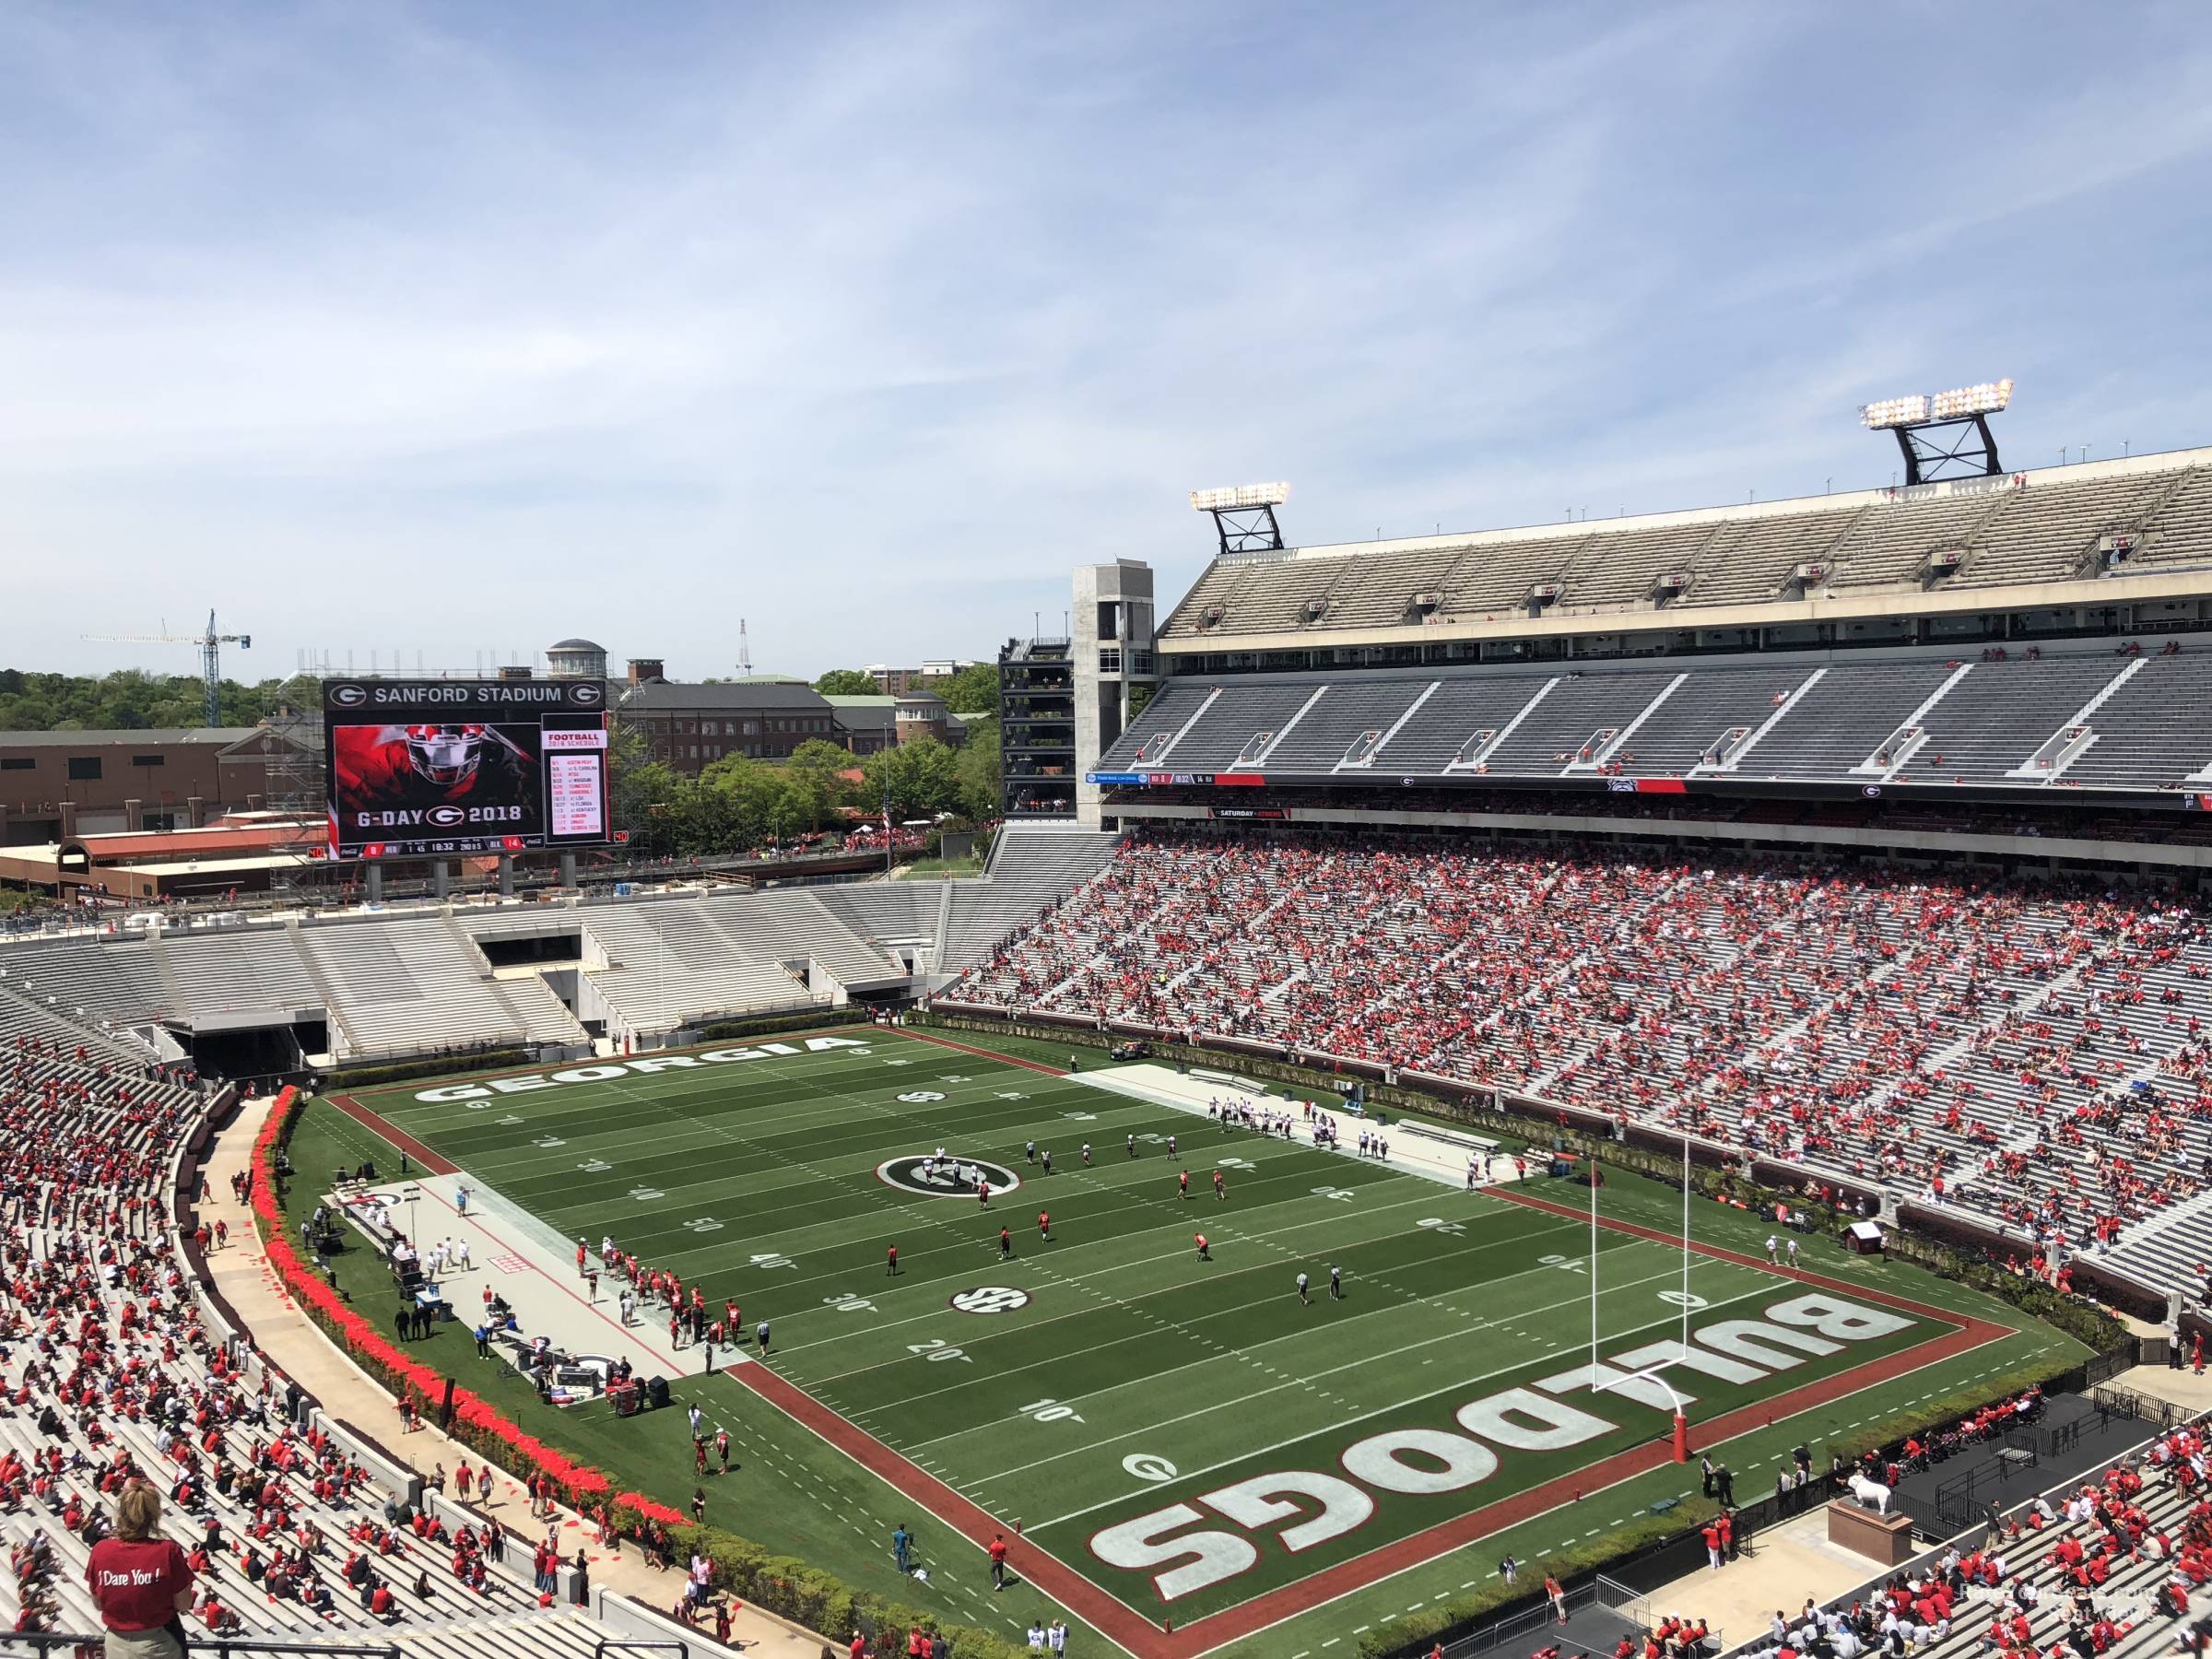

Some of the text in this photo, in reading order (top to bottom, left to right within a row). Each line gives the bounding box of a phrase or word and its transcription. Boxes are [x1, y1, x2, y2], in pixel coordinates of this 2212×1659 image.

[374, 687, 561, 702] SANFORD STADIUM
[358, 810, 422, 827] G-DAY
[469, 806, 521, 821] 2018
[508, 839, 516, 847] 14
[616, 831, 627, 841] 40
[310, 848, 323, 857] 40
[371, 846, 377, 855] 8
[431, 842, 454, 852] 18:32
[414, 1037, 872, 1102] GEORGIA
[1218, 1158, 1257, 1170] 40
[628, 1187, 665, 1200] 40
[1310, 1186, 1354, 1200] 30
[683, 1218, 724, 1232] 50
[1416, 1218, 1467, 1233] 20
[749, 1253, 793, 1269] 40
[1537, 1254, 1584, 1269] 10
[822, 1292, 872, 1313] 30
[953, 1287, 1030, 1312] SEC
[907, 1339, 964, 1362] 20
[1018, 1398, 1074, 1422] 10
[1091, 1292, 1918, 1600] BULLDOGS
[1122, 1453, 1177, 1481] G
[103, 1570, 129, 1586] Dare
[131, 1569, 152, 1585] You
